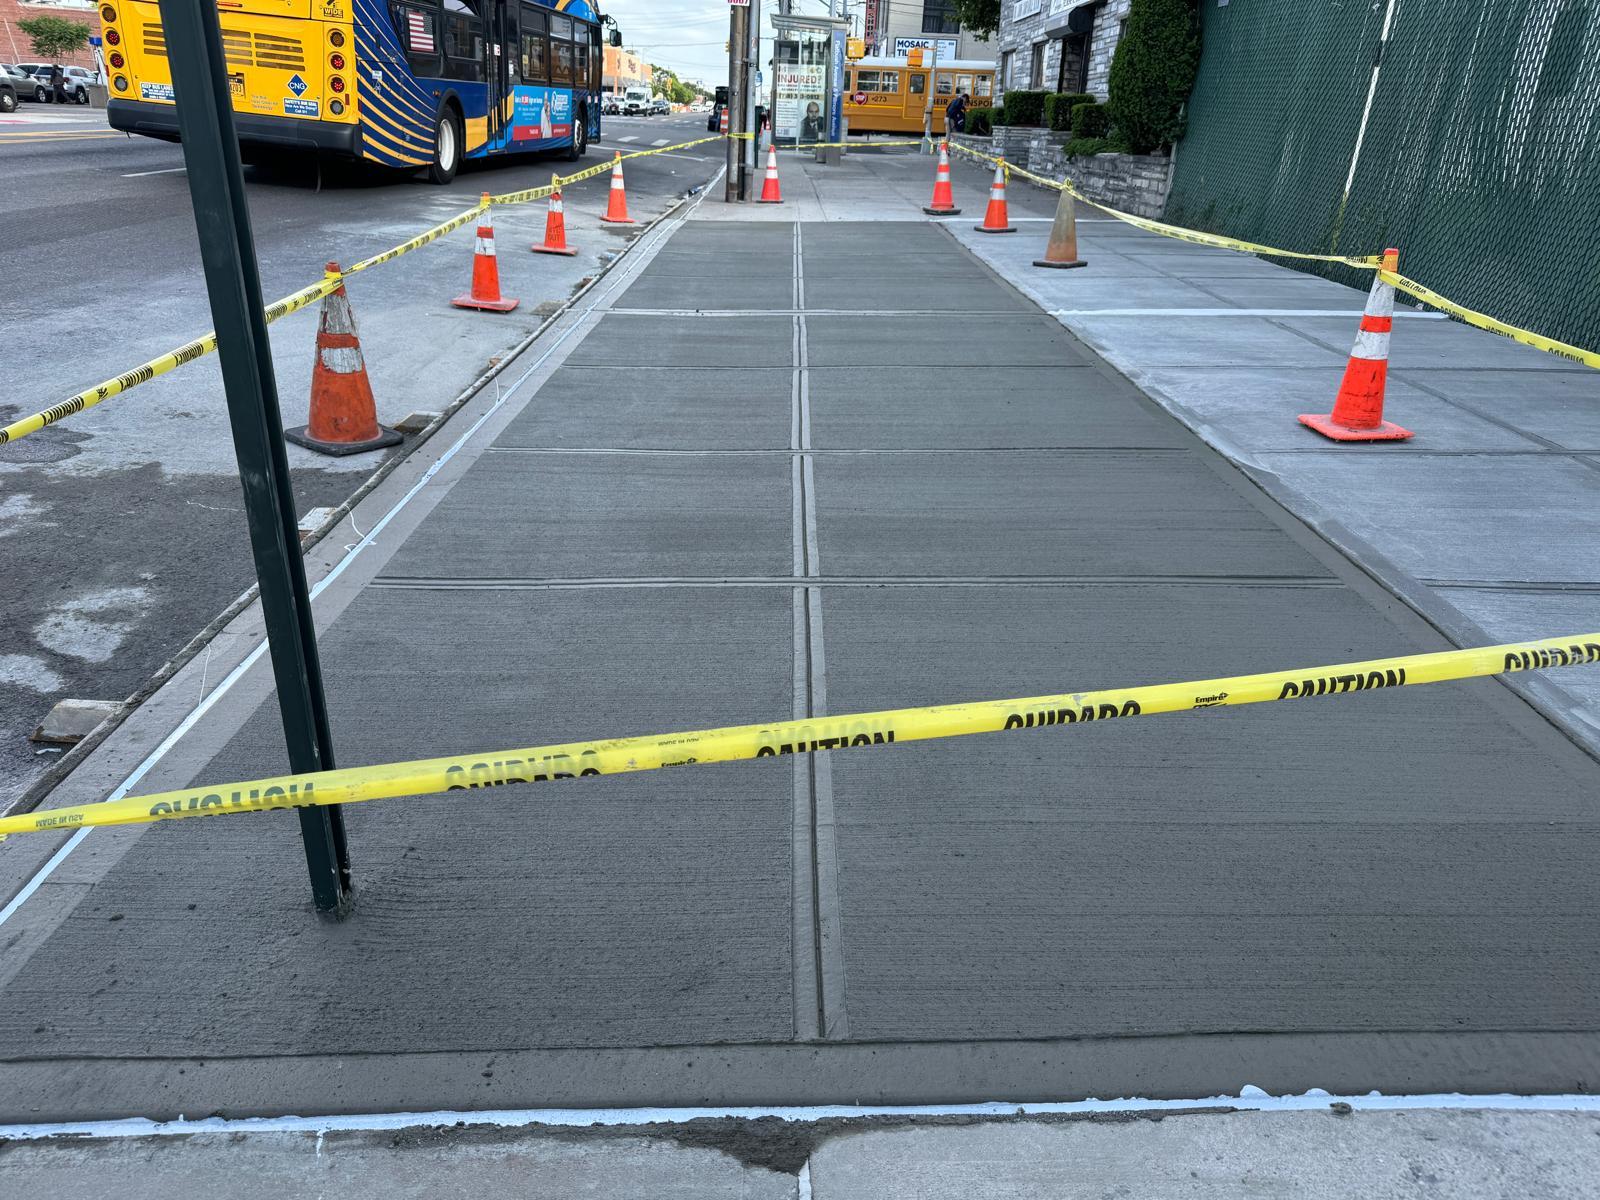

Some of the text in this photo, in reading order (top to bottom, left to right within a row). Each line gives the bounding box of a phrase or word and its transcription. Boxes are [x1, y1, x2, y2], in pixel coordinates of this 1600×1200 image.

[897, 40, 929, 48] MOSAIC
[897, 49, 909, 57] TIL
[289, 82, 305, 90] CNG
[1277, 668, 1406, 701] CAUTION
